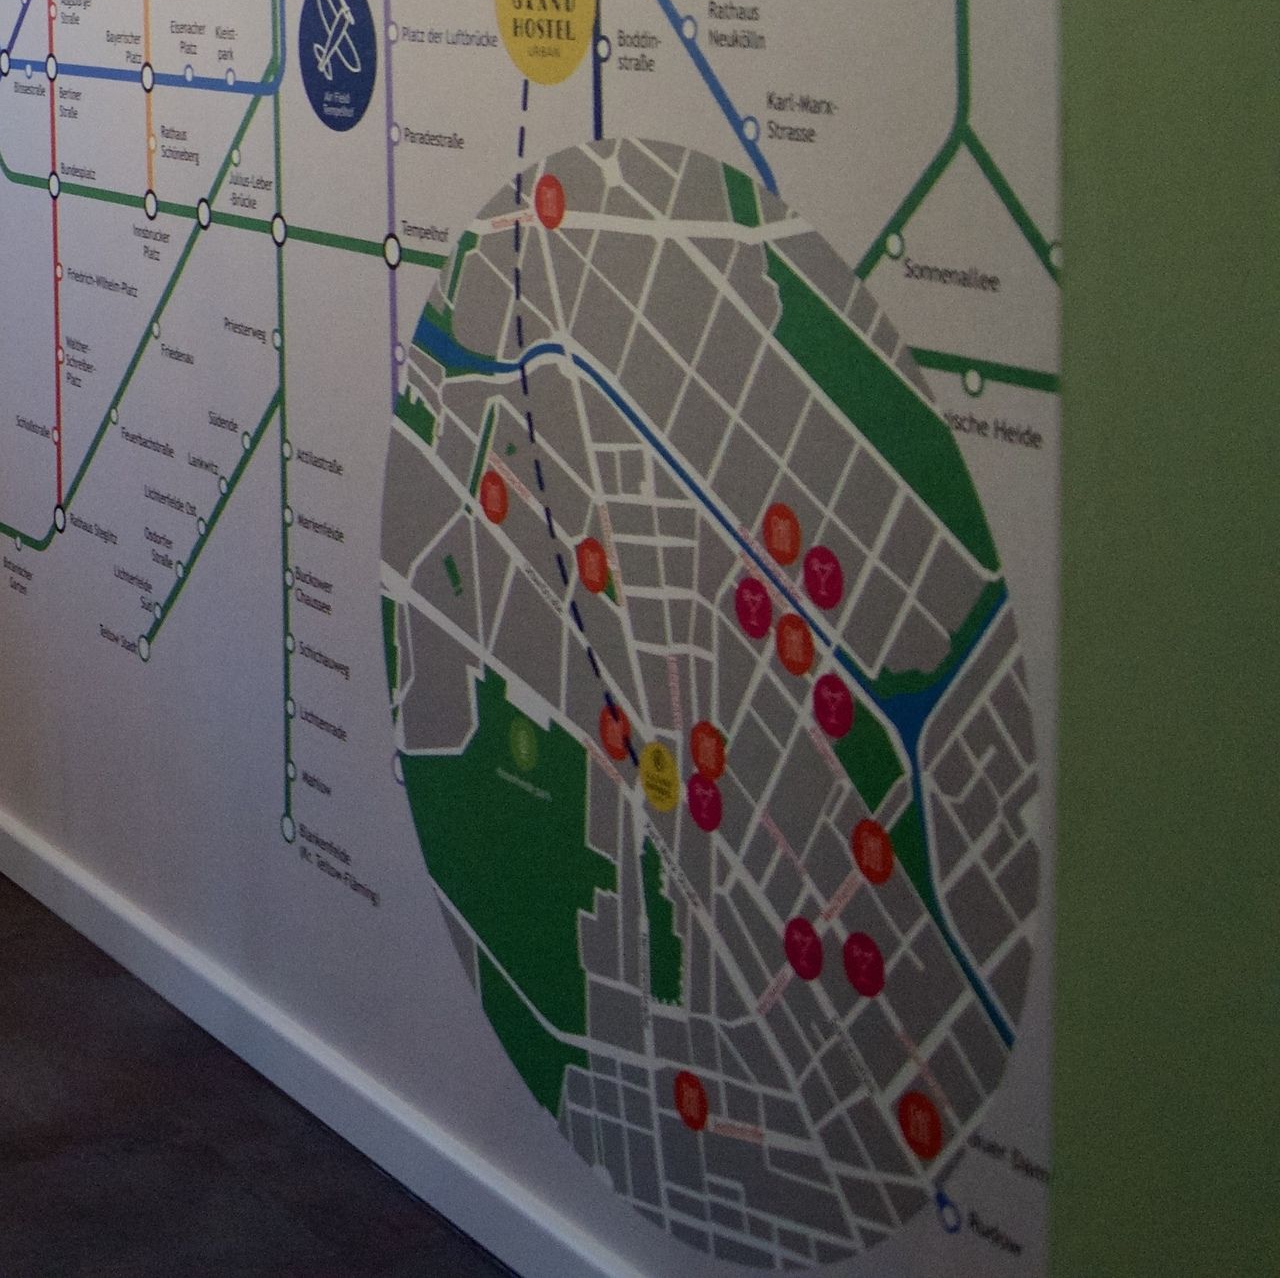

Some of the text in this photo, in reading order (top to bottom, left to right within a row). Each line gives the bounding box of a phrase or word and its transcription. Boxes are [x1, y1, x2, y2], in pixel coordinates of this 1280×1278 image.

[708, 0, 760, 22] Rathaus
[512, 18, 577, 41] HOSTEL
[404, 127, 465, 150] Paradestraße
[402, 220, 450, 243] Tempelhof
